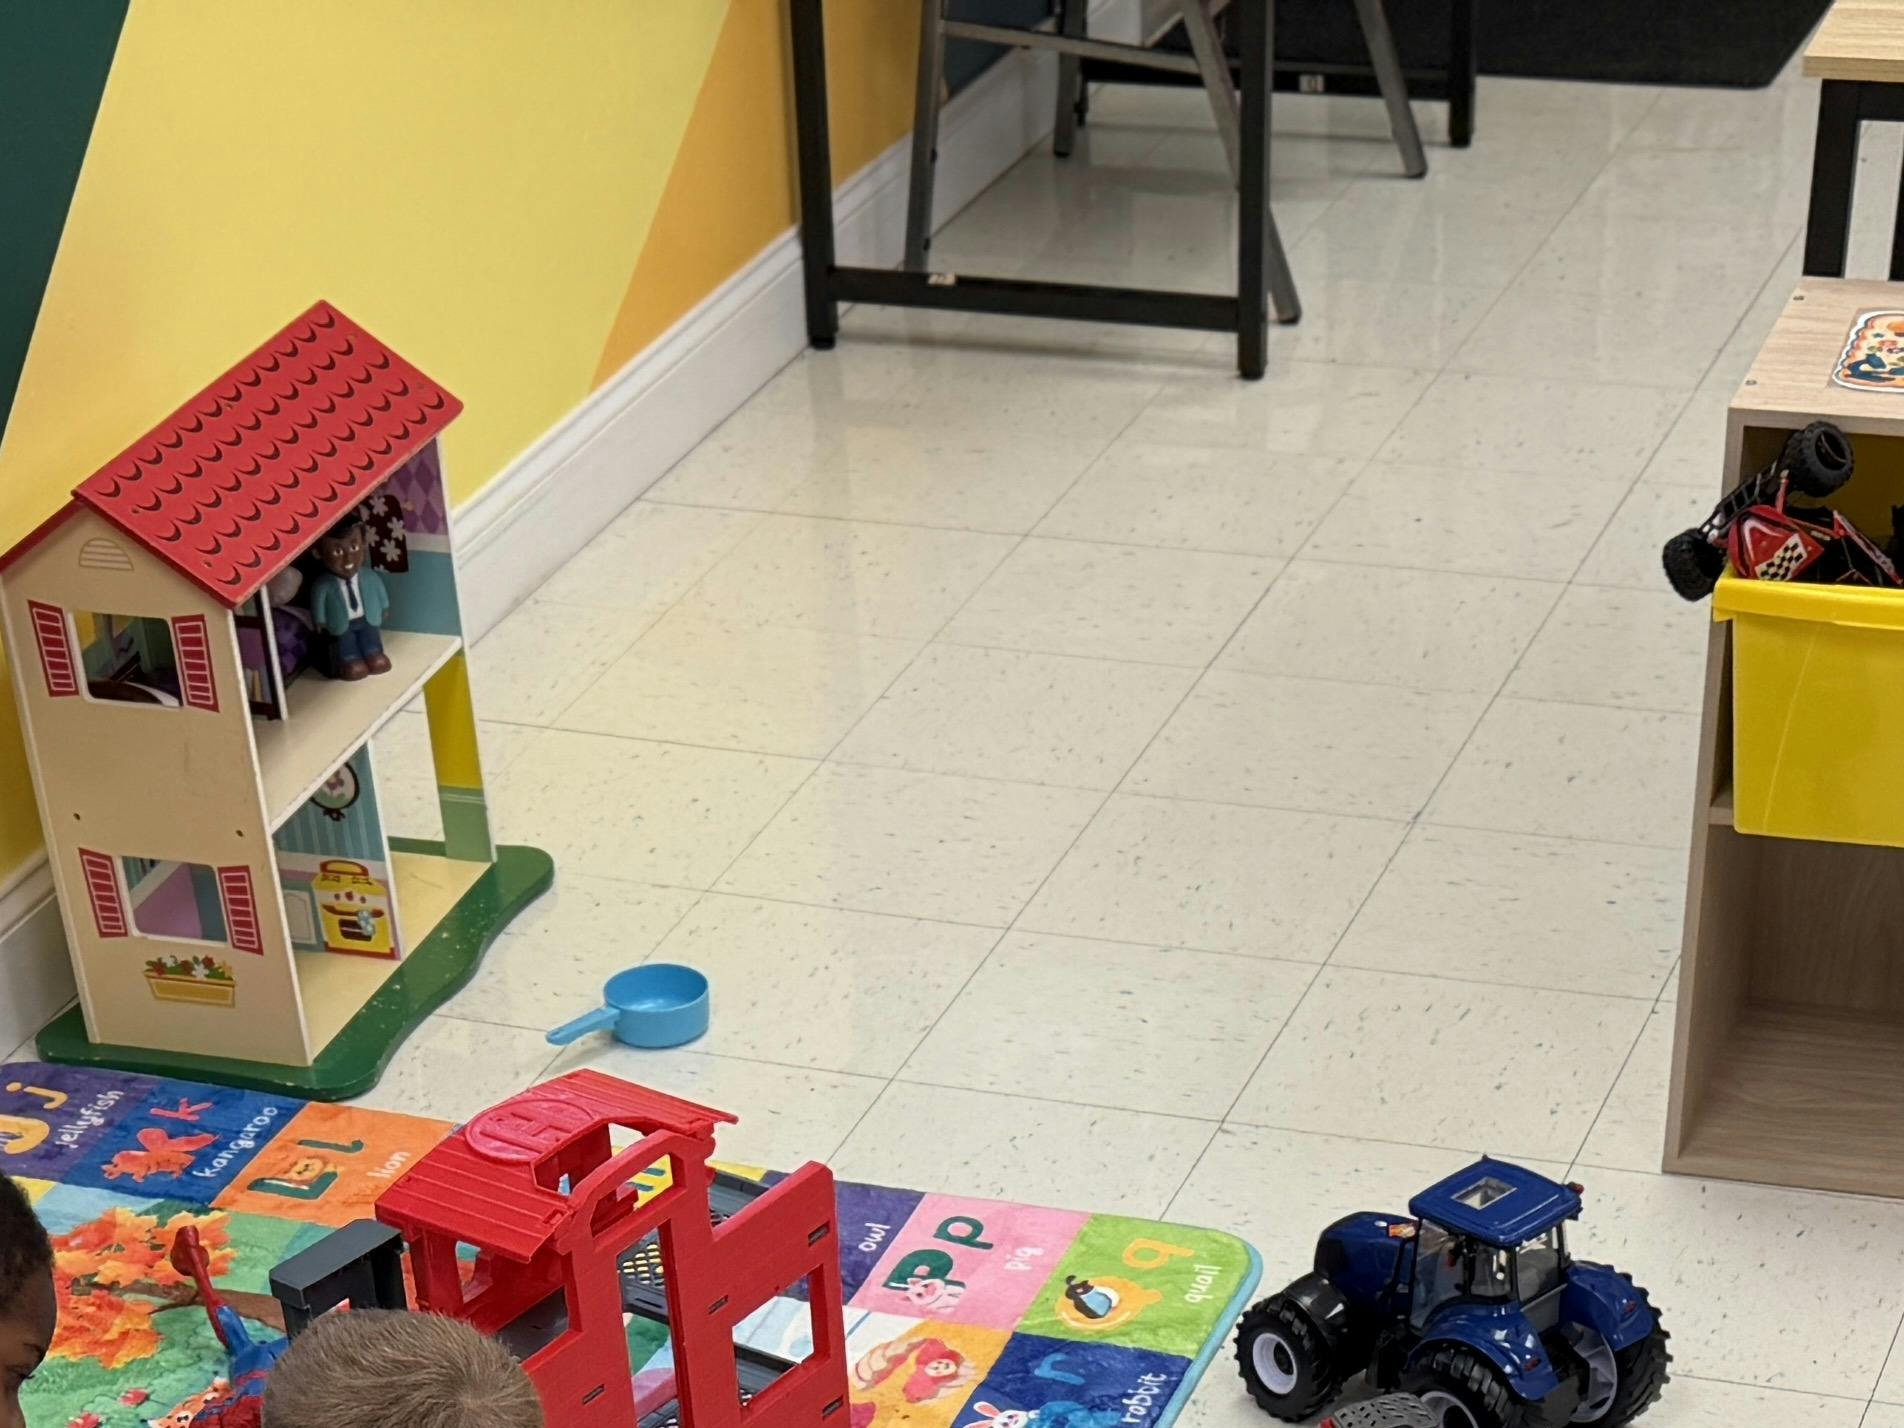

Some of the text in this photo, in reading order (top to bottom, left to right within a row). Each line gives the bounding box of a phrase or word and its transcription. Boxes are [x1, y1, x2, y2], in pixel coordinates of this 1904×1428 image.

[55, 1090, 124, 1149] jellyfish
[193, 1106, 278, 1178] kangaroo
[367, 1151, 411, 1179] lion
[858, 1223, 891, 1252] owl
[933, 1215, 994, 1250] p
[1004, 1247, 1044, 1272] pig
[1184, 1264, 1222, 1305] quail
[1121, 1371, 1167, 1425] rabbit
